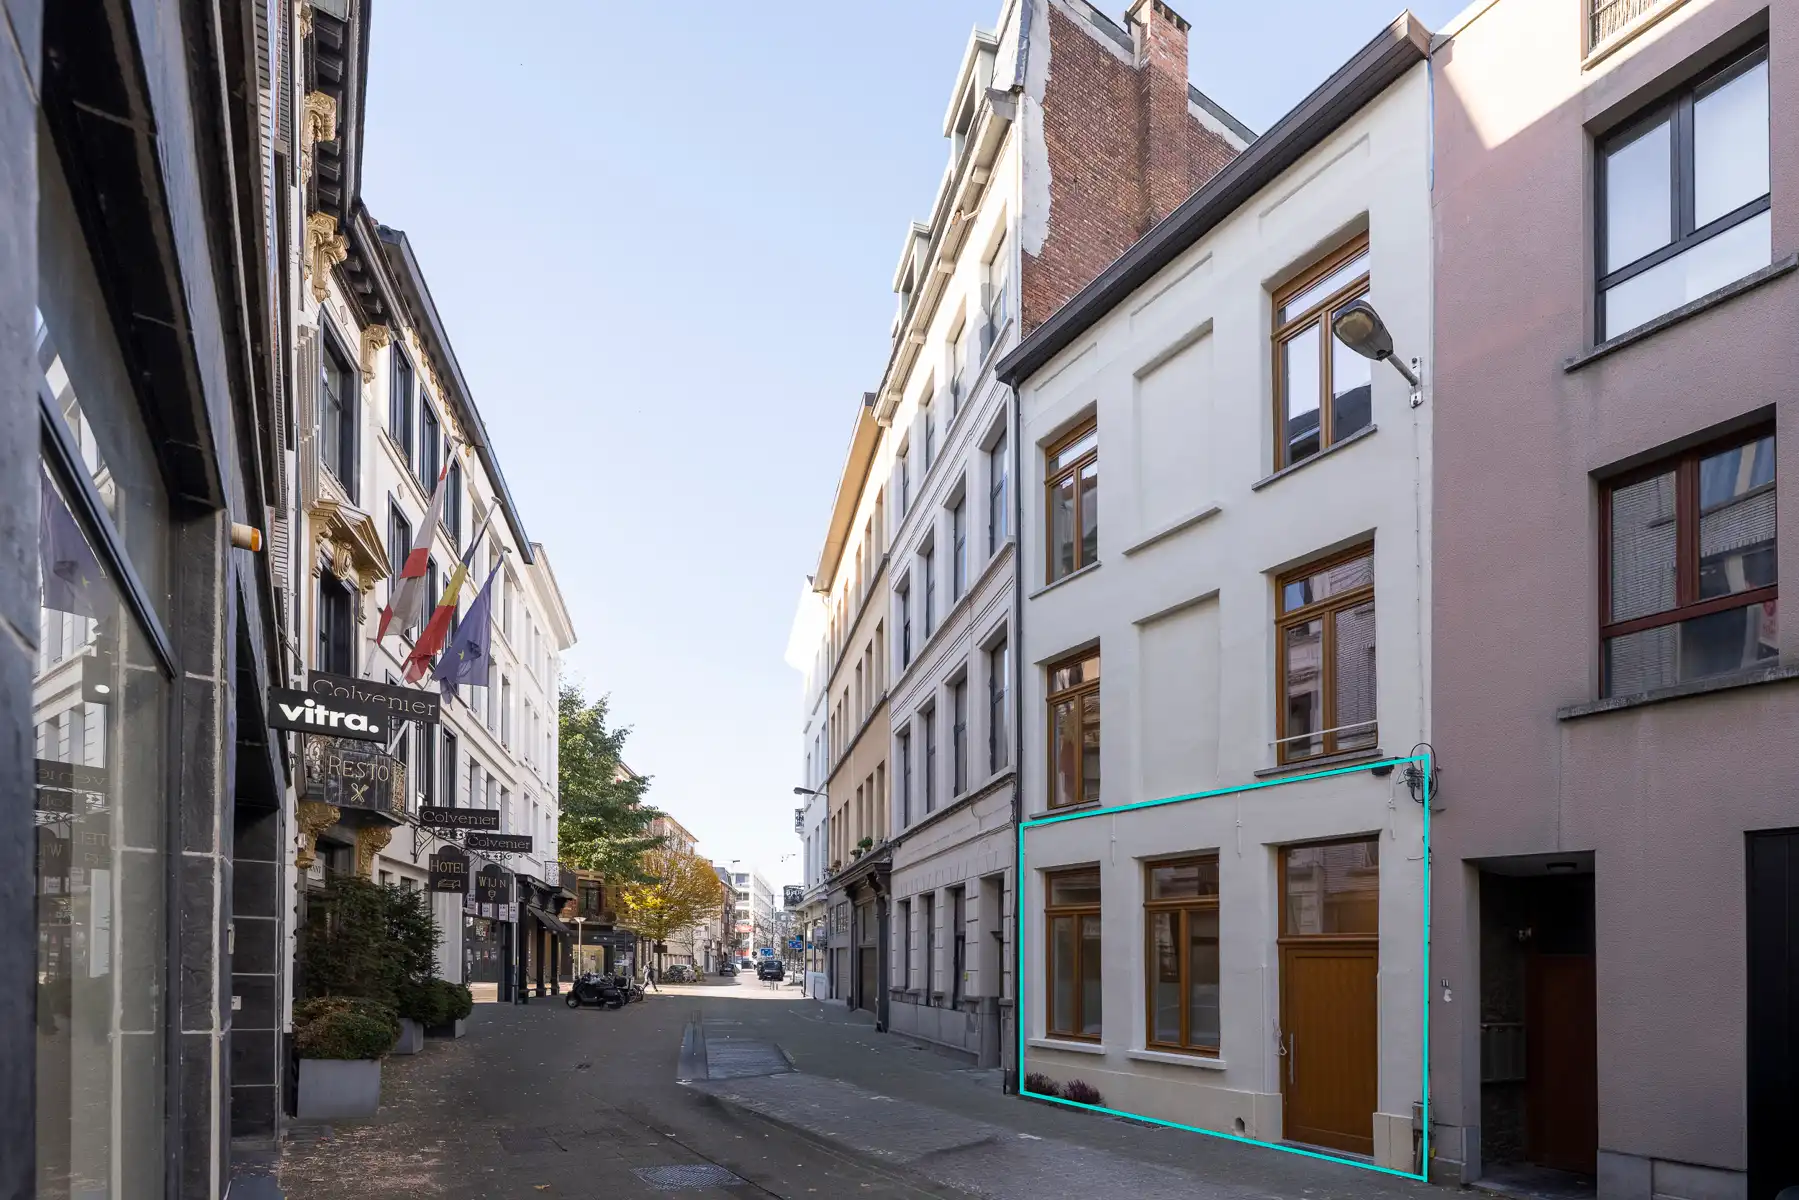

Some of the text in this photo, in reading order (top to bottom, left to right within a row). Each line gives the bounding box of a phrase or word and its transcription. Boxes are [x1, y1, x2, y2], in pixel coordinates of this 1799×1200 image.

[278, 698, 380, 734] vitra.
[328, 755, 389, 781] RESTO
[422, 810, 497, 826] Colvenier
[467, 833, 531, 849] Colvenier
[430, 859, 468, 874] HOTEL
[478, 876, 507, 888] WIJN
